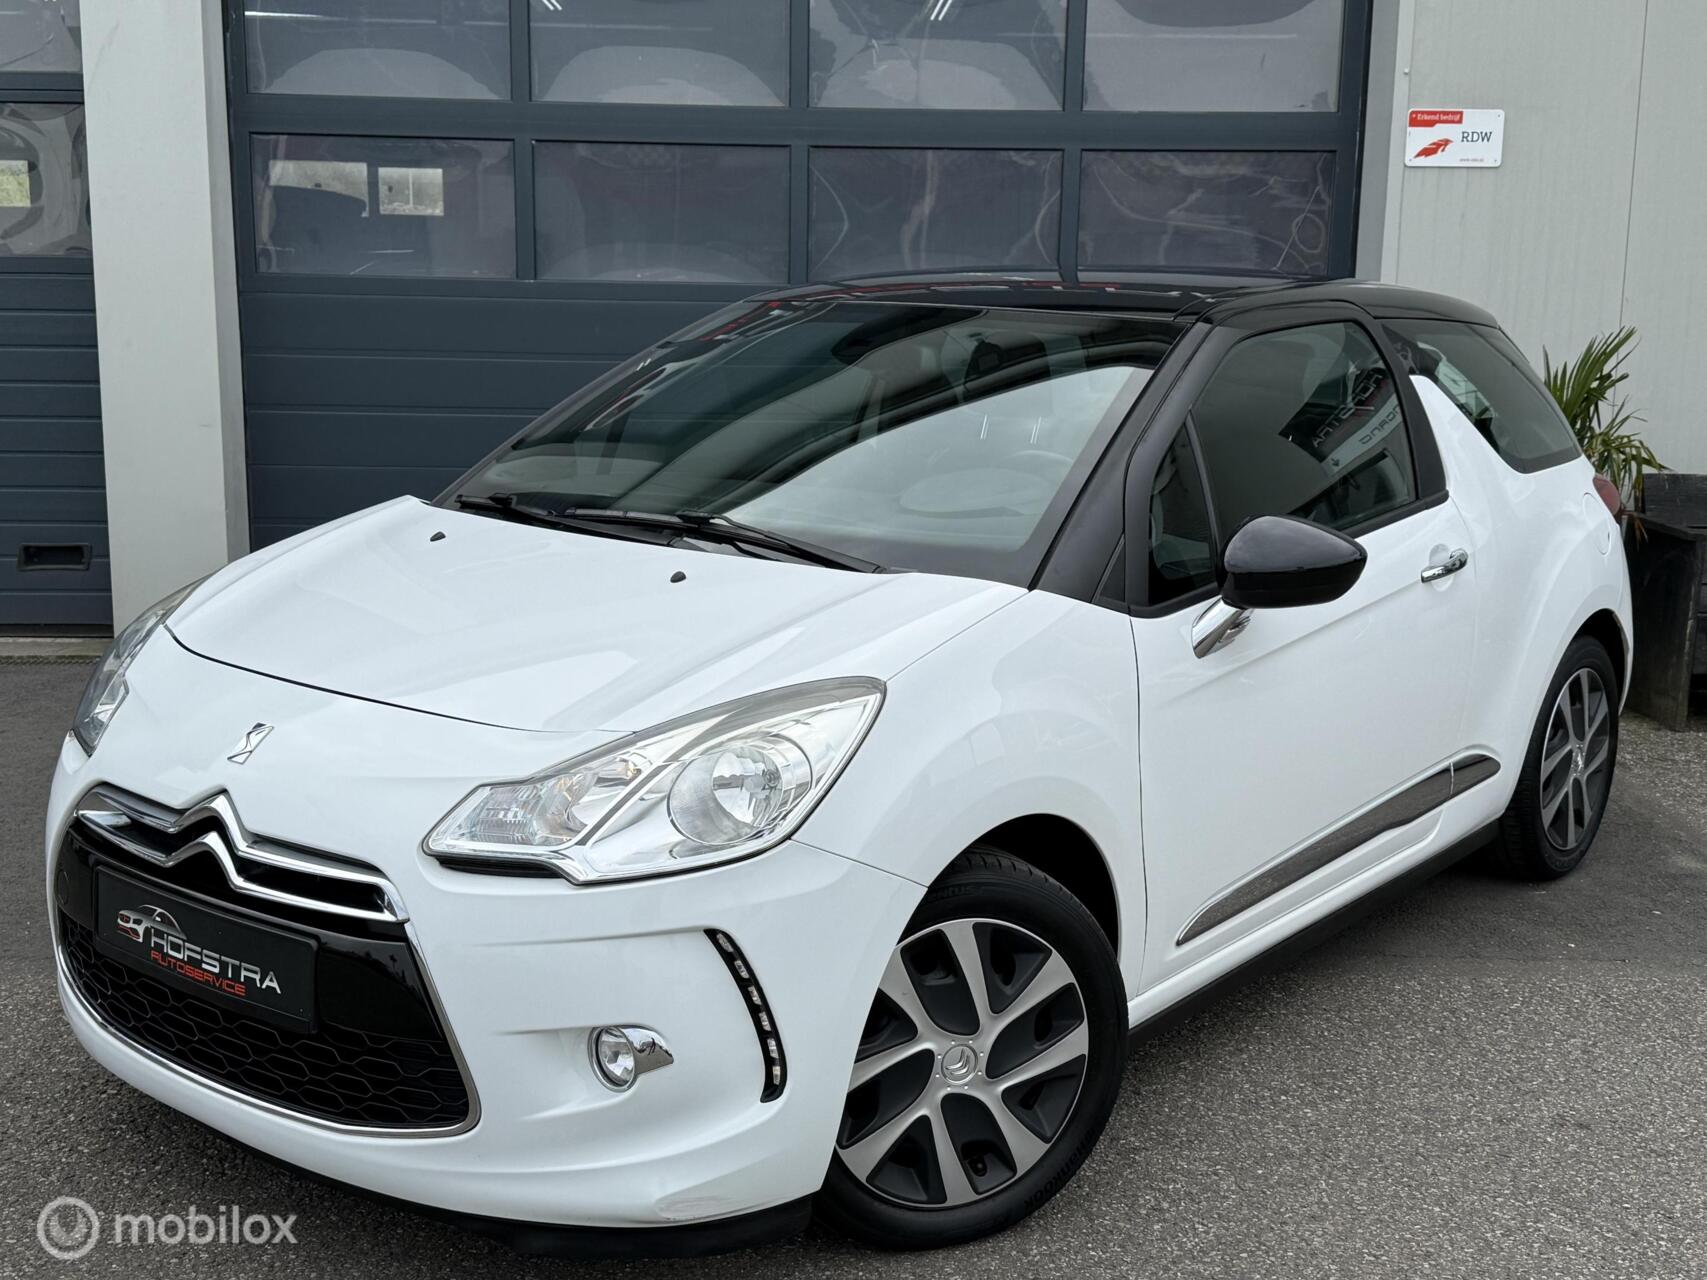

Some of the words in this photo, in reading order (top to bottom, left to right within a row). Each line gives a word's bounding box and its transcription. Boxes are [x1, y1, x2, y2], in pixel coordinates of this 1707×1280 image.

[1460, 131, 1493, 143] RDW
[150, 925, 282, 994] HOFSTRA
[150, 950, 247, 997] AUTOSERVICE
